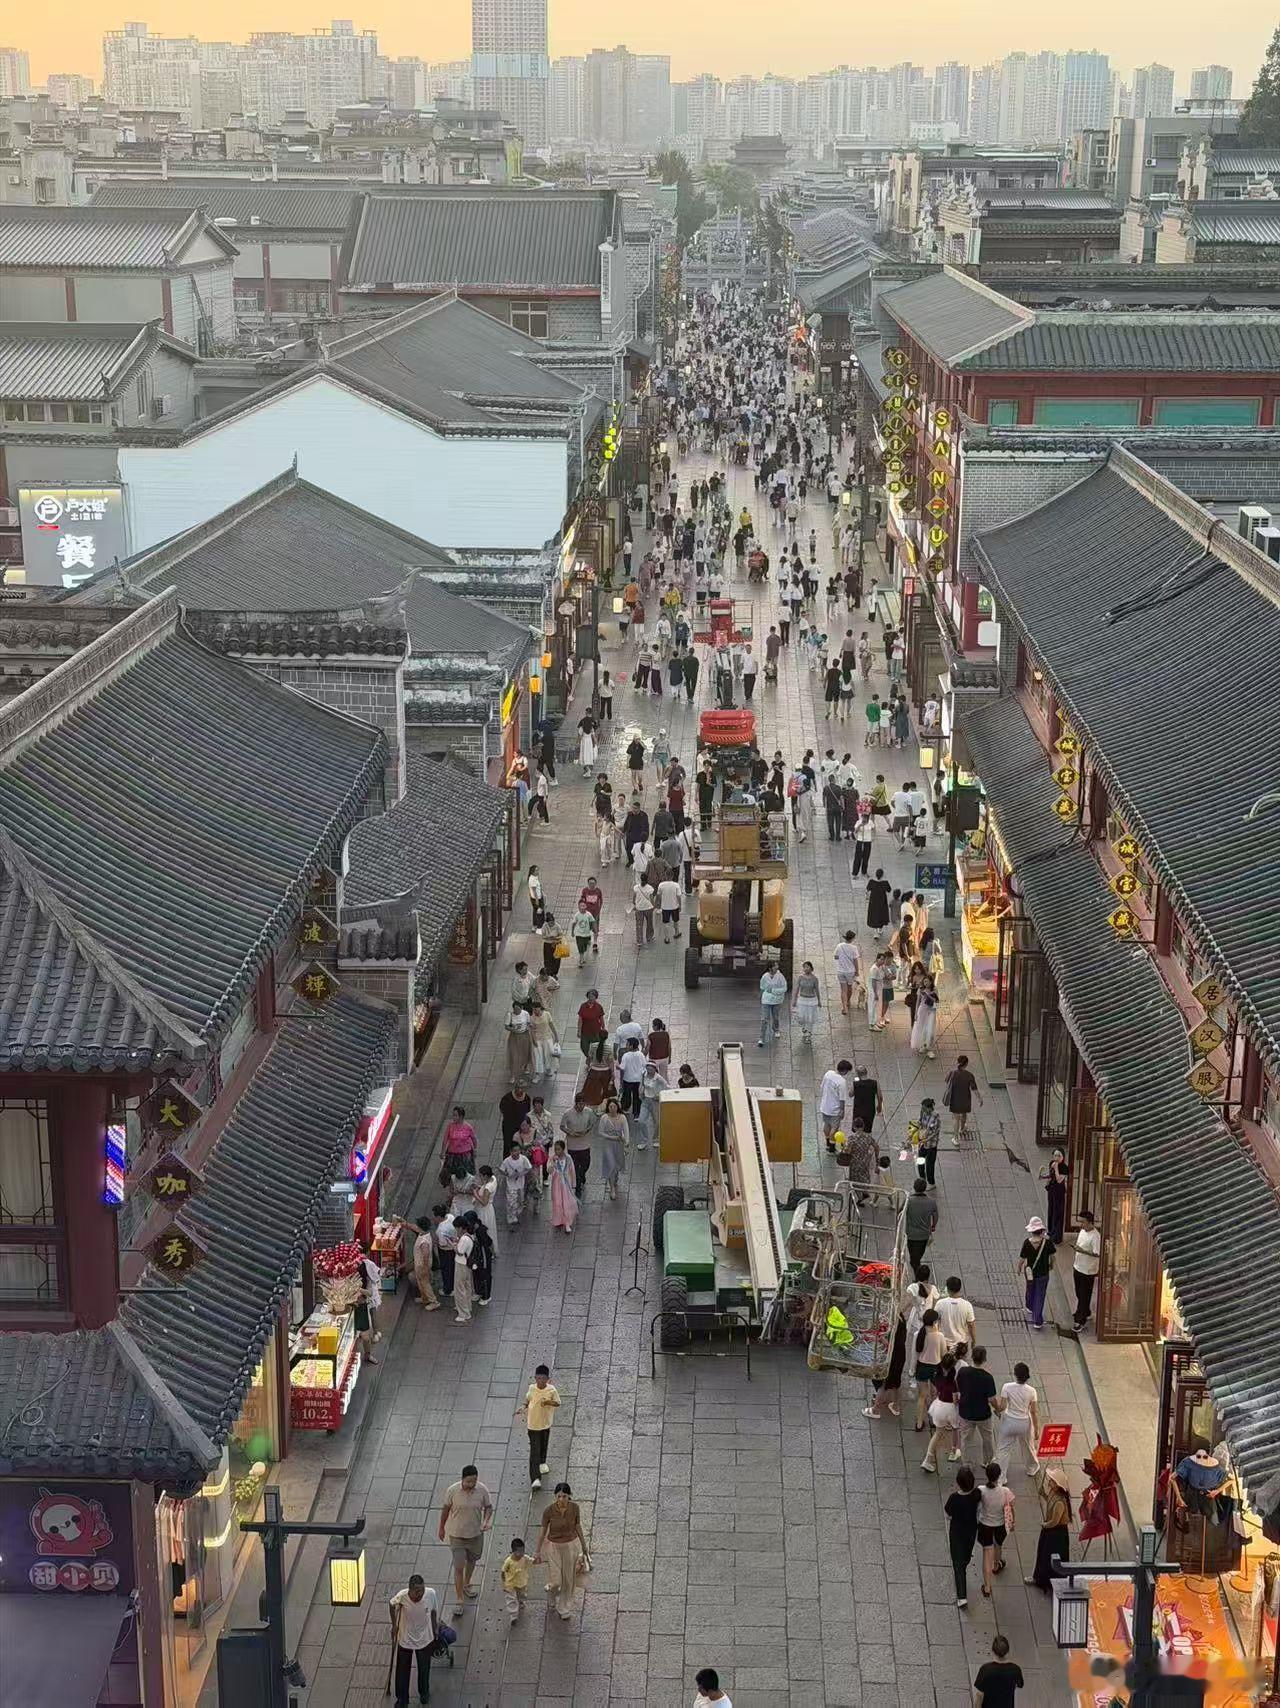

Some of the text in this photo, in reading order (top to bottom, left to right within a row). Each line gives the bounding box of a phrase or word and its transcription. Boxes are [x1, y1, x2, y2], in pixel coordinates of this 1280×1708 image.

[65, 498, 107, 513] 户大姐
[1196, 985, 1219, 1086] 居汉服
[156, 1100, 187, 1267] 大咖秀
[34, 1566, 115, 1586] 甜小贝
